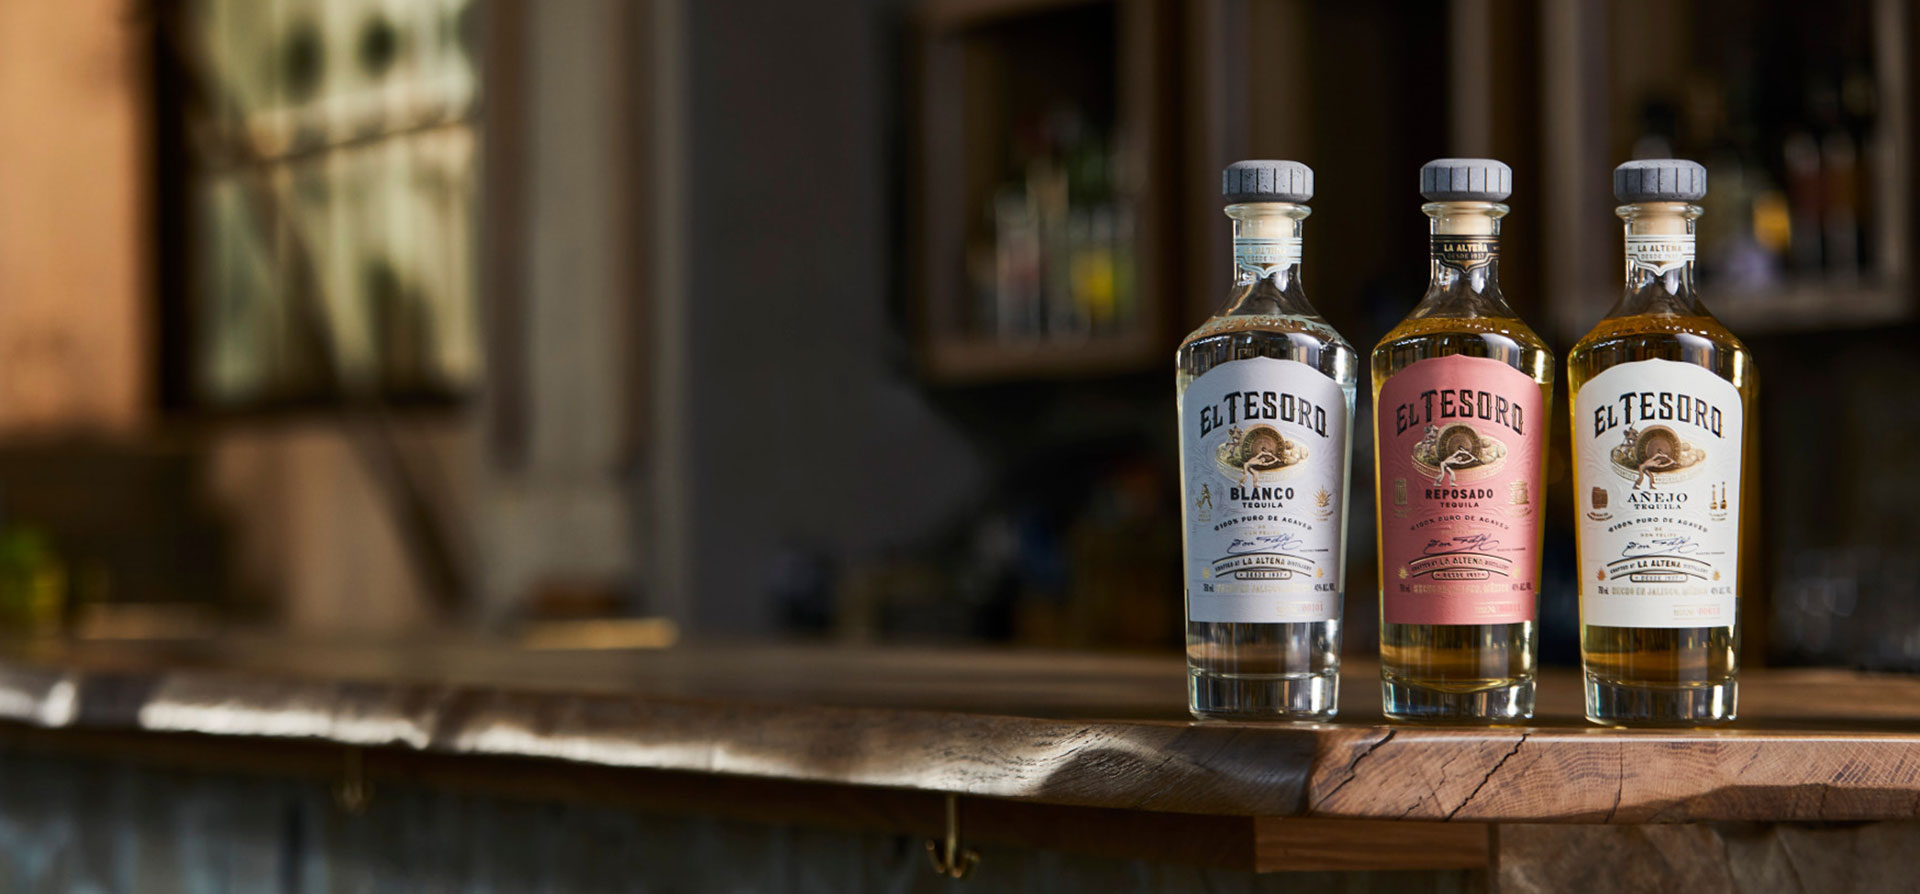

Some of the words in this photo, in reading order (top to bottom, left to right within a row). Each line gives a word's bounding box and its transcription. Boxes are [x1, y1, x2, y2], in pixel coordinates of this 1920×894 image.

[1443, 244, 1454, 252] LA
[1200, 405, 1223, 438] EL
[1224, 391, 1327, 438] TESORO
[1396, 404, 1419, 436] EL
[1420, 389, 1523, 435] TESORO
[1594, 405, 1618, 439] EL
[1619, 392, 1723, 438] TESORO
[1230, 487, 1294, 501] BLANCO
[1425, 489, 1494, 500] REPOSADO
[1627, 491, 1688, 503] AÑEJO
[1241, 515, 1264, 523] PURO
[1282, 517, 1307, 528] AGAVE
[1480, 517, 1503, 527] AGAVE
[1678, 519, 1703, 530] AGAVE
[1637, 560, 1648, 568] LA
